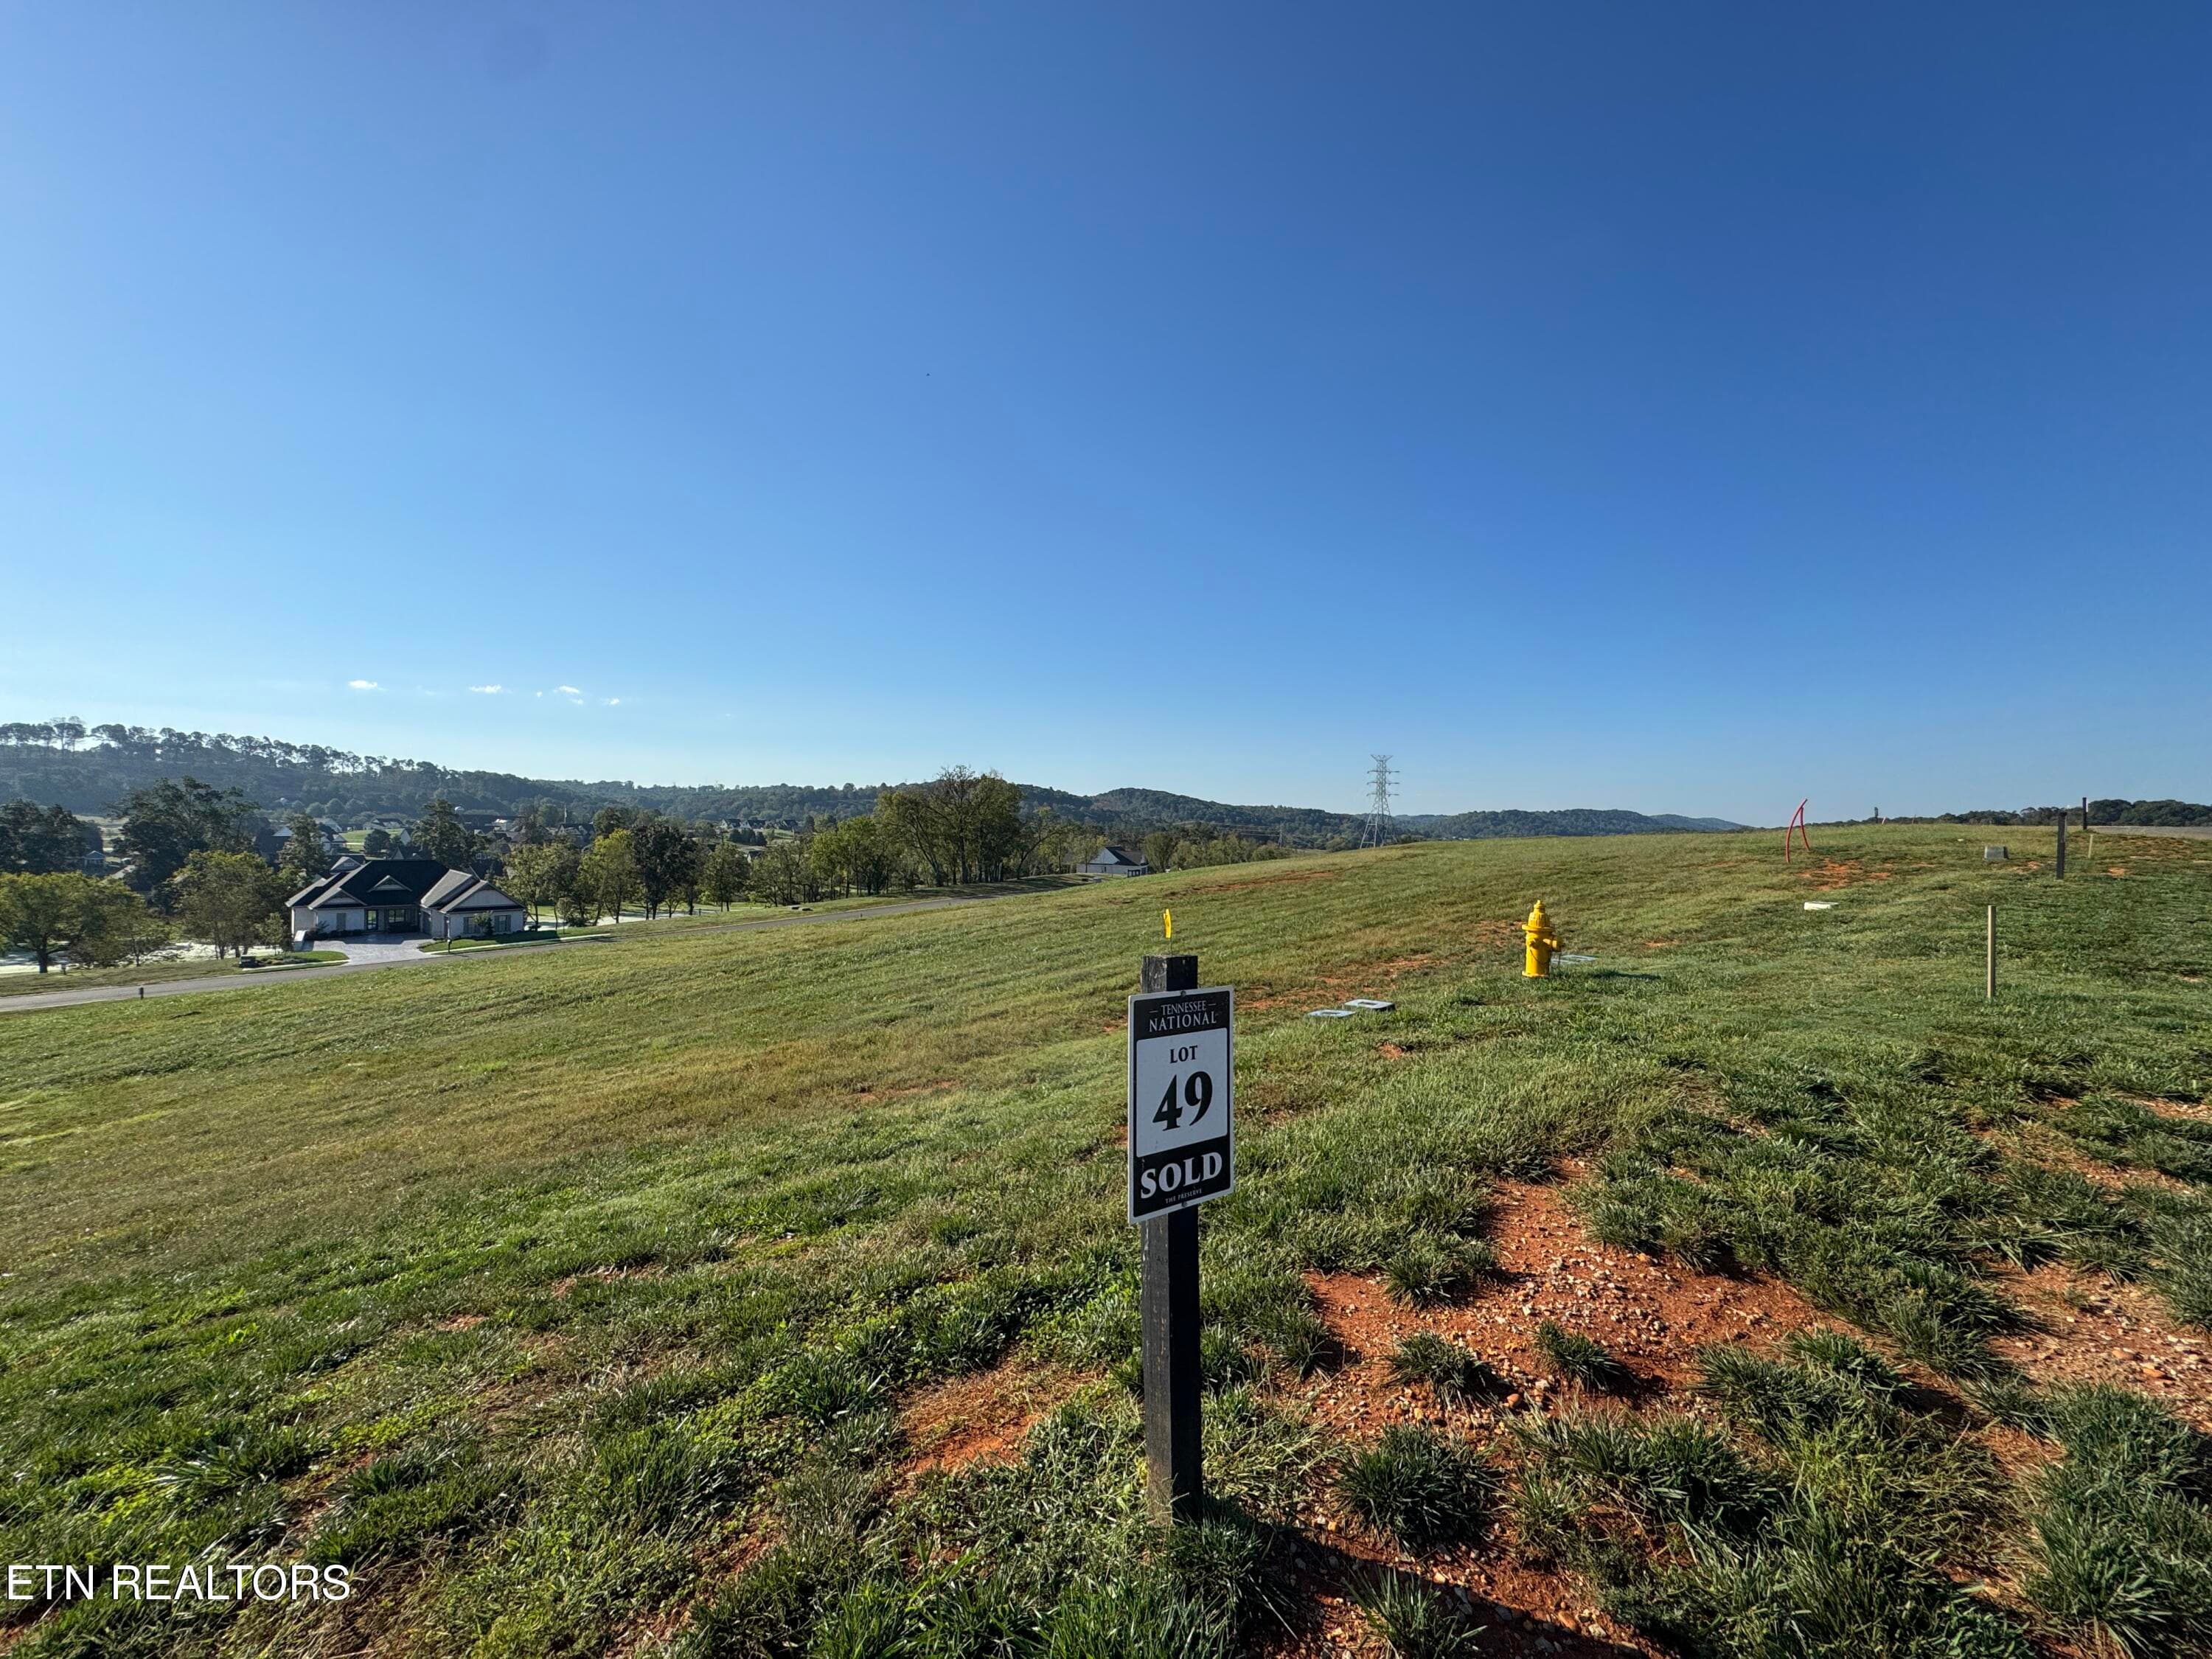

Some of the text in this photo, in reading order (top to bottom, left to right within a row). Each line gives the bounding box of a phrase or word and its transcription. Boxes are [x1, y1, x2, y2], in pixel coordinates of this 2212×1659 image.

[1161, 1000, 1207, 1015] TENNESSEE
[1149, 1011, 1217, 1032] NATIONAL
[1169, 1045, 1198, 1064] LOT
[1152, 1071, 1213, 1131] 49
[1141, 1152, 1222, 1199] SOLD
[1165, 1195, 1176, 1204] THE
